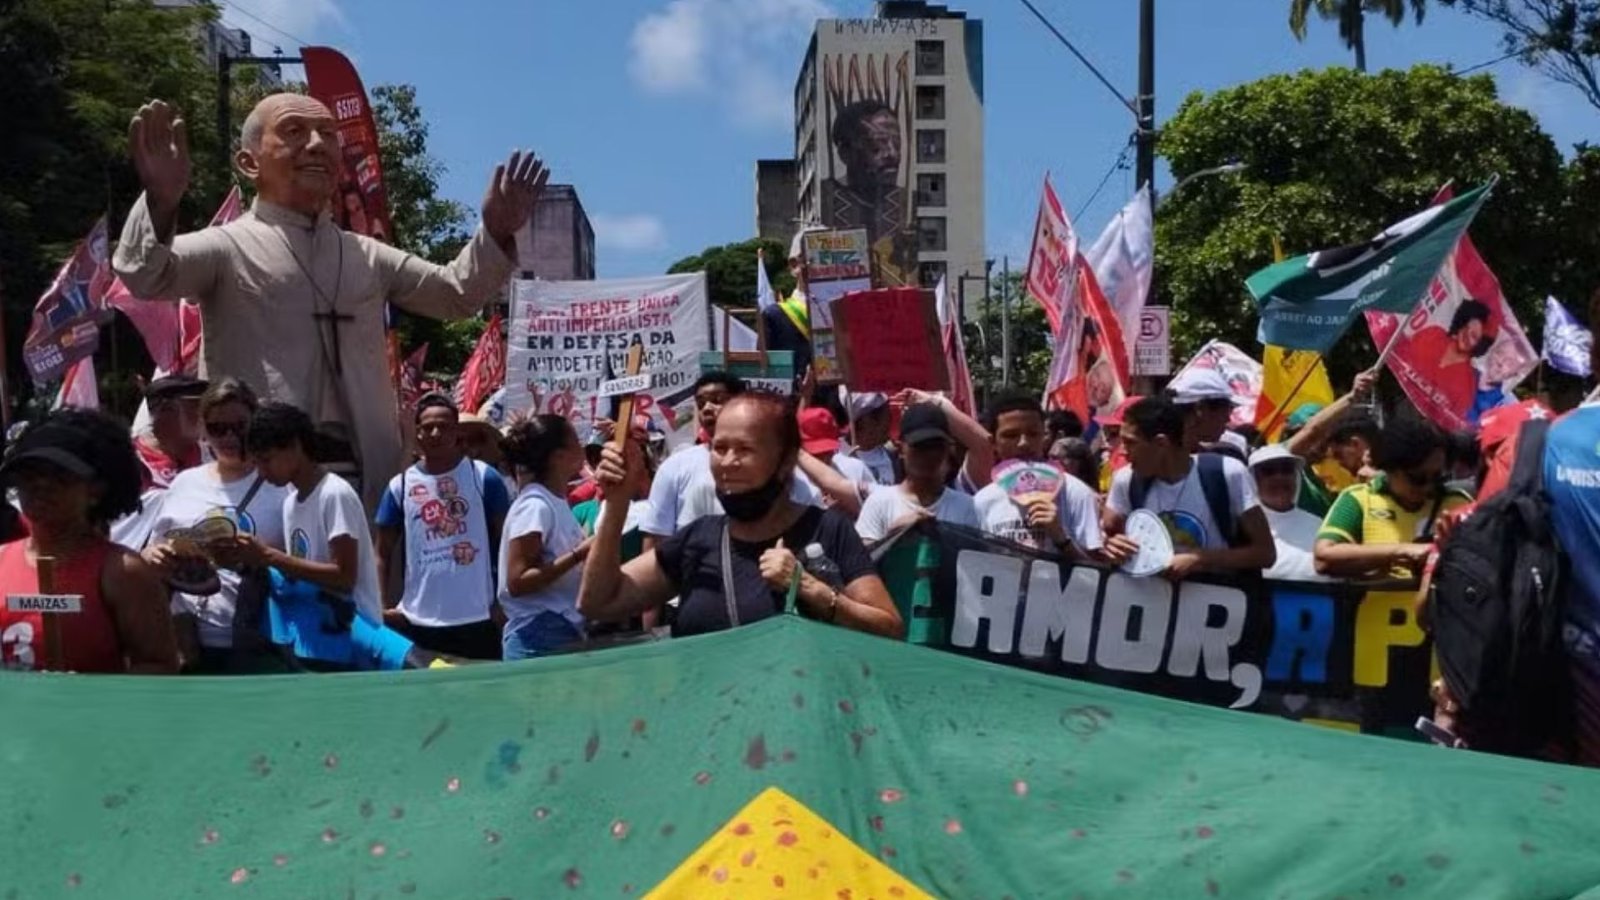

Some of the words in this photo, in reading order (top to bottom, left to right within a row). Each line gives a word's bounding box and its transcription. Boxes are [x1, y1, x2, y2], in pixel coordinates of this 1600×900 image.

[571, 299, 630, 317] FRENTE
[527, 312, 672, 332] ANTI-IMPERIALISTA
[527, 335, 554, 350] EM
[563, 333, 643, 350] DEFESA
[650, 329, 675, 345] DA
[20, 597, 69, 609] MAIZAS
[951, 549, 1262, 709] AMOR,
[1353, 590, 1427, 687] P
